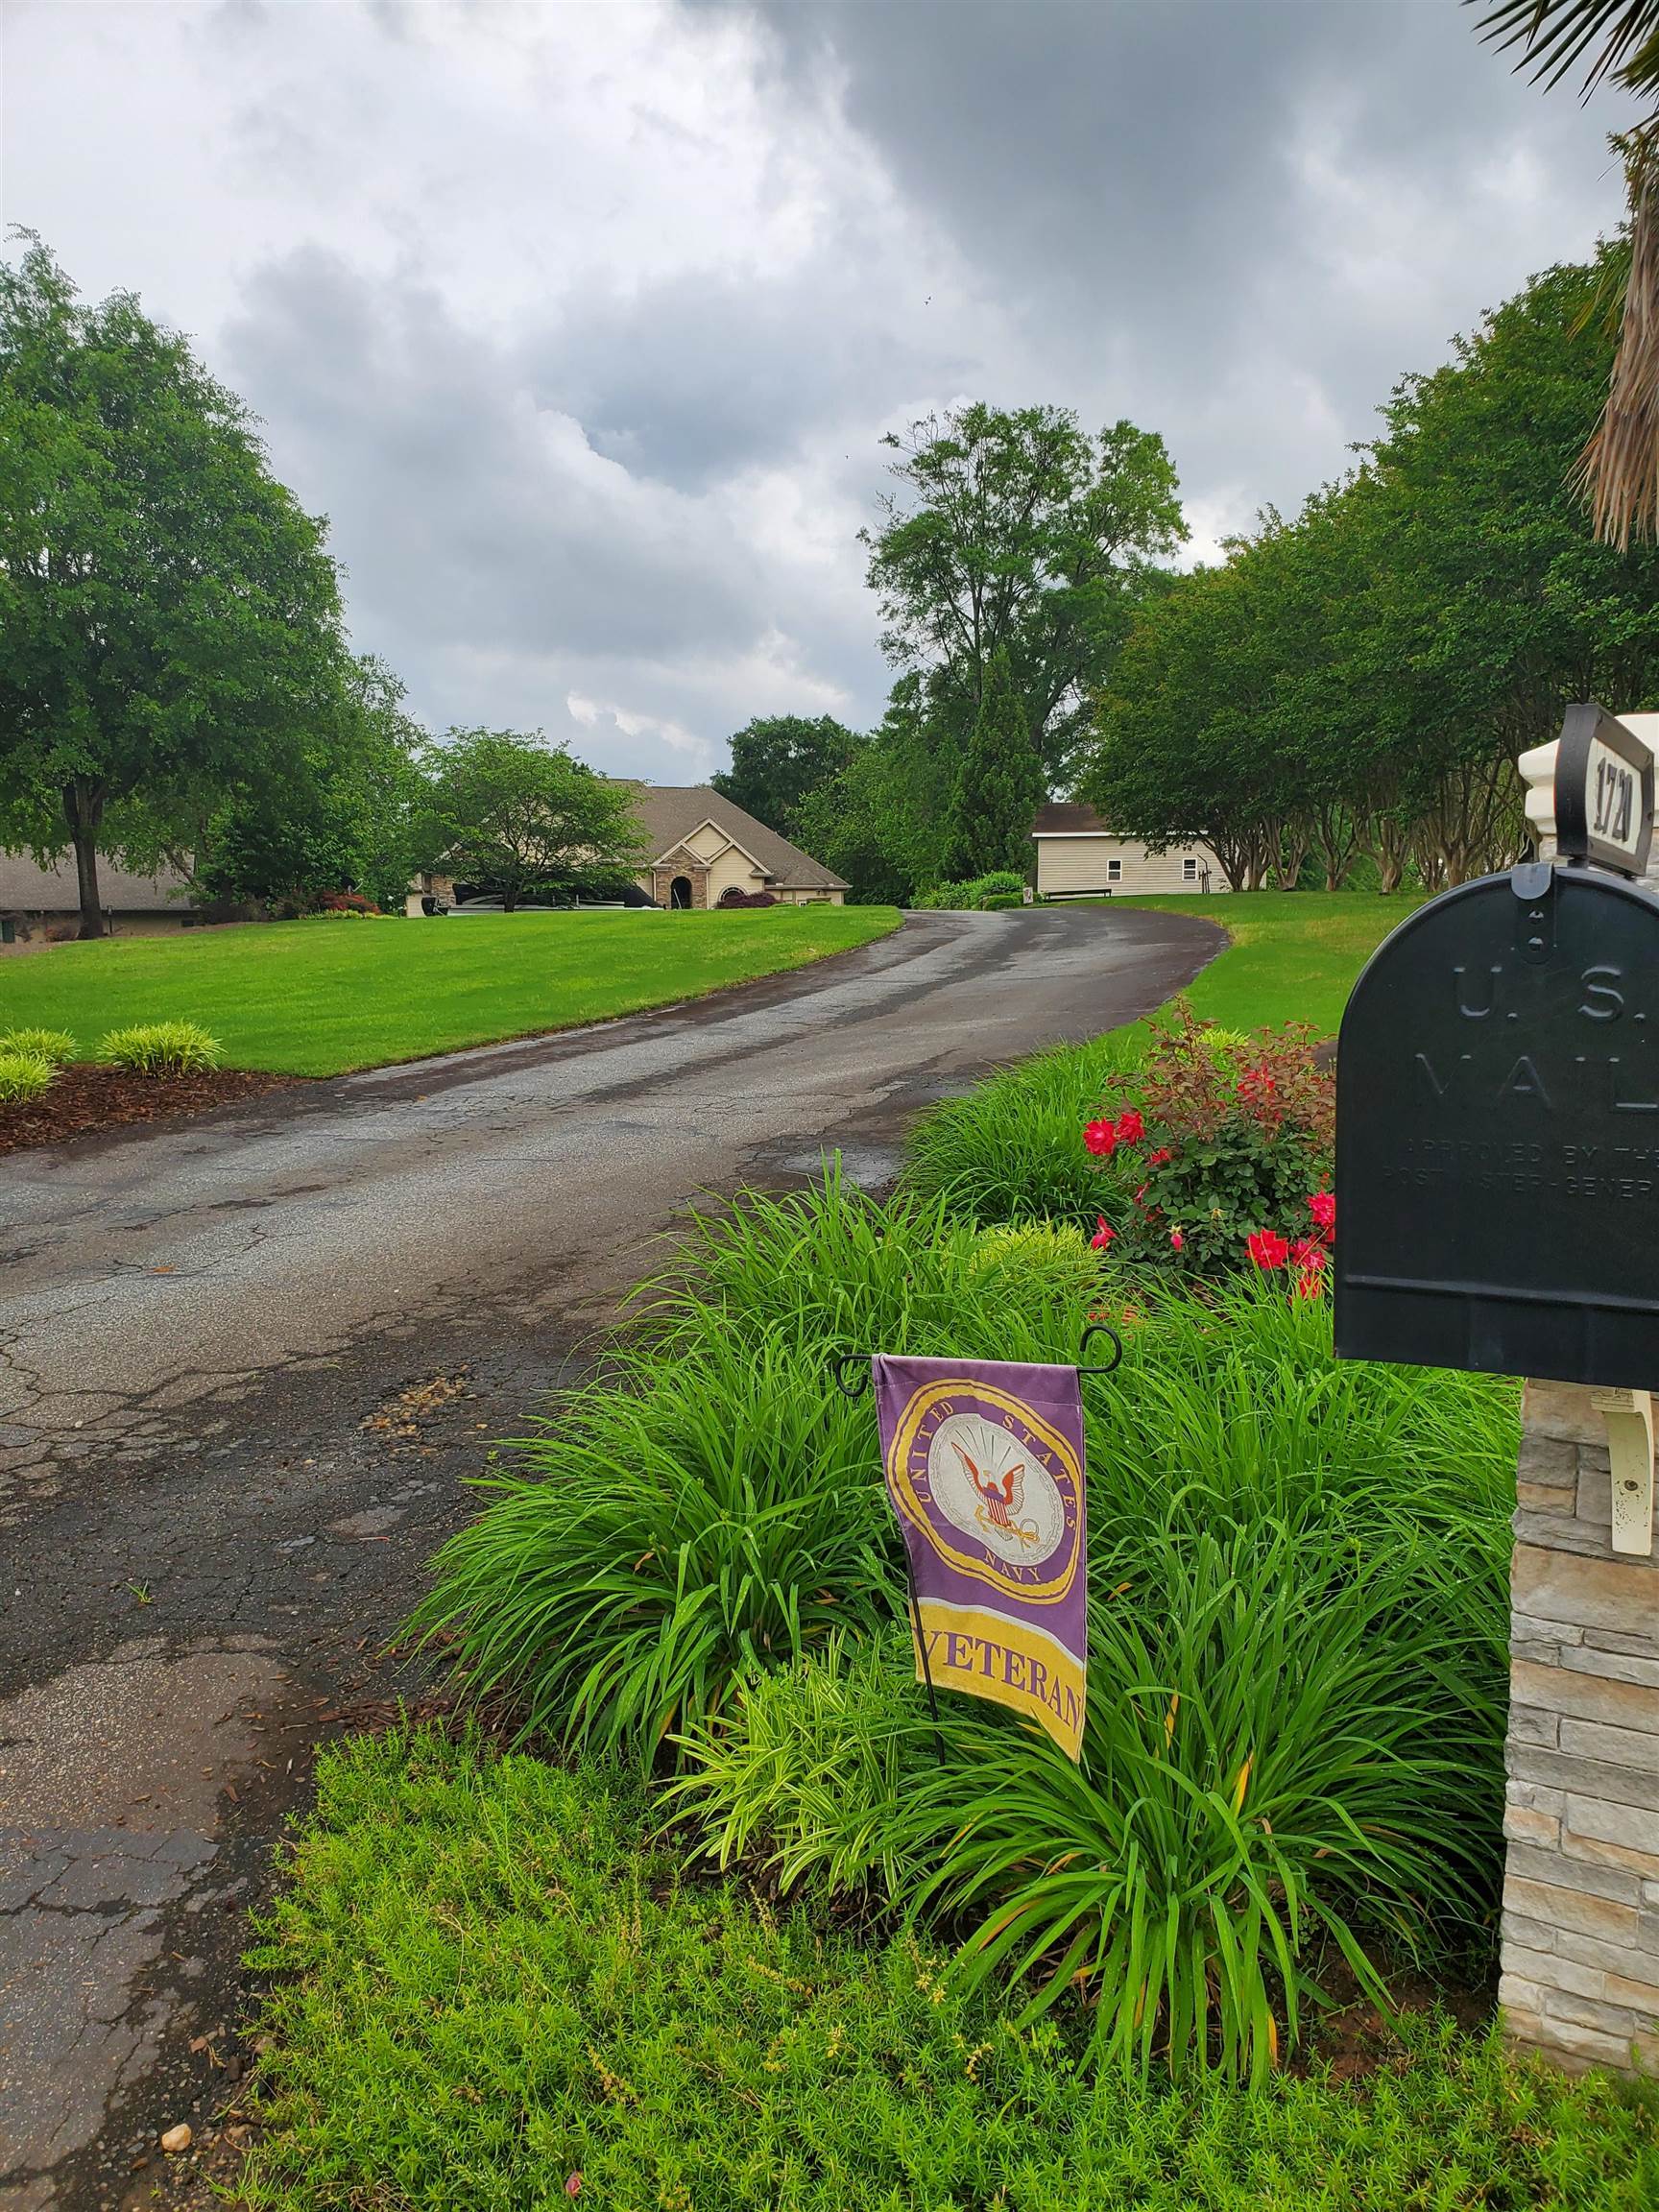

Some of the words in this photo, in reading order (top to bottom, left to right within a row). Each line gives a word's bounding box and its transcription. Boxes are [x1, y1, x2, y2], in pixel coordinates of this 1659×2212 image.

[1594, 757, 1633, 842] 1720
[1560, 1144, 1598, 1165] BY
[911, 1401, 954, 1503] UNITED
[1002, 1414, 1076, 1530] STATES
[984, 1550, 1041, 1582] NAVY
[912, 1627, 1082, 1734] VETERAN
